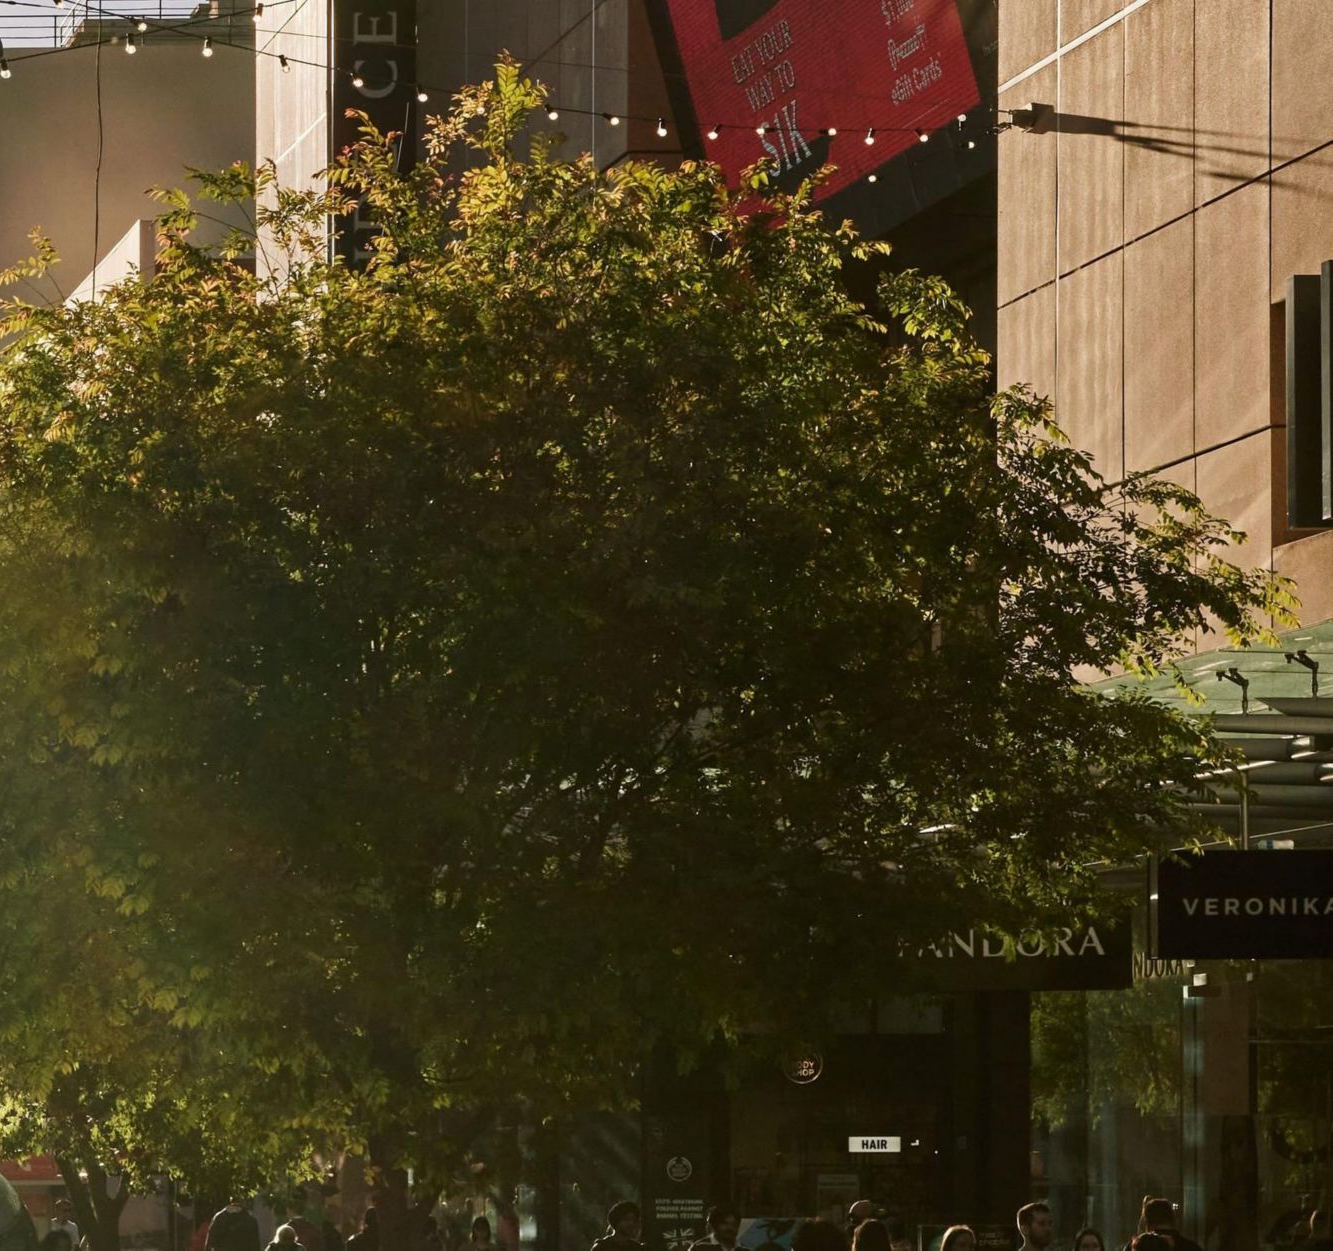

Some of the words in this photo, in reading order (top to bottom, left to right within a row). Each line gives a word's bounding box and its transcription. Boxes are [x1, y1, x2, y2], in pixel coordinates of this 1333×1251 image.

[731, 45, 755, 84] EAT
[753, 20, 794, 66] YOUR
[744, 71, 775, 113] WAY
[773, 60, 795, 93] TO
[903, 926, 1106, 958] ANDORA
[860, 1139, 888, 1150] HAIR
